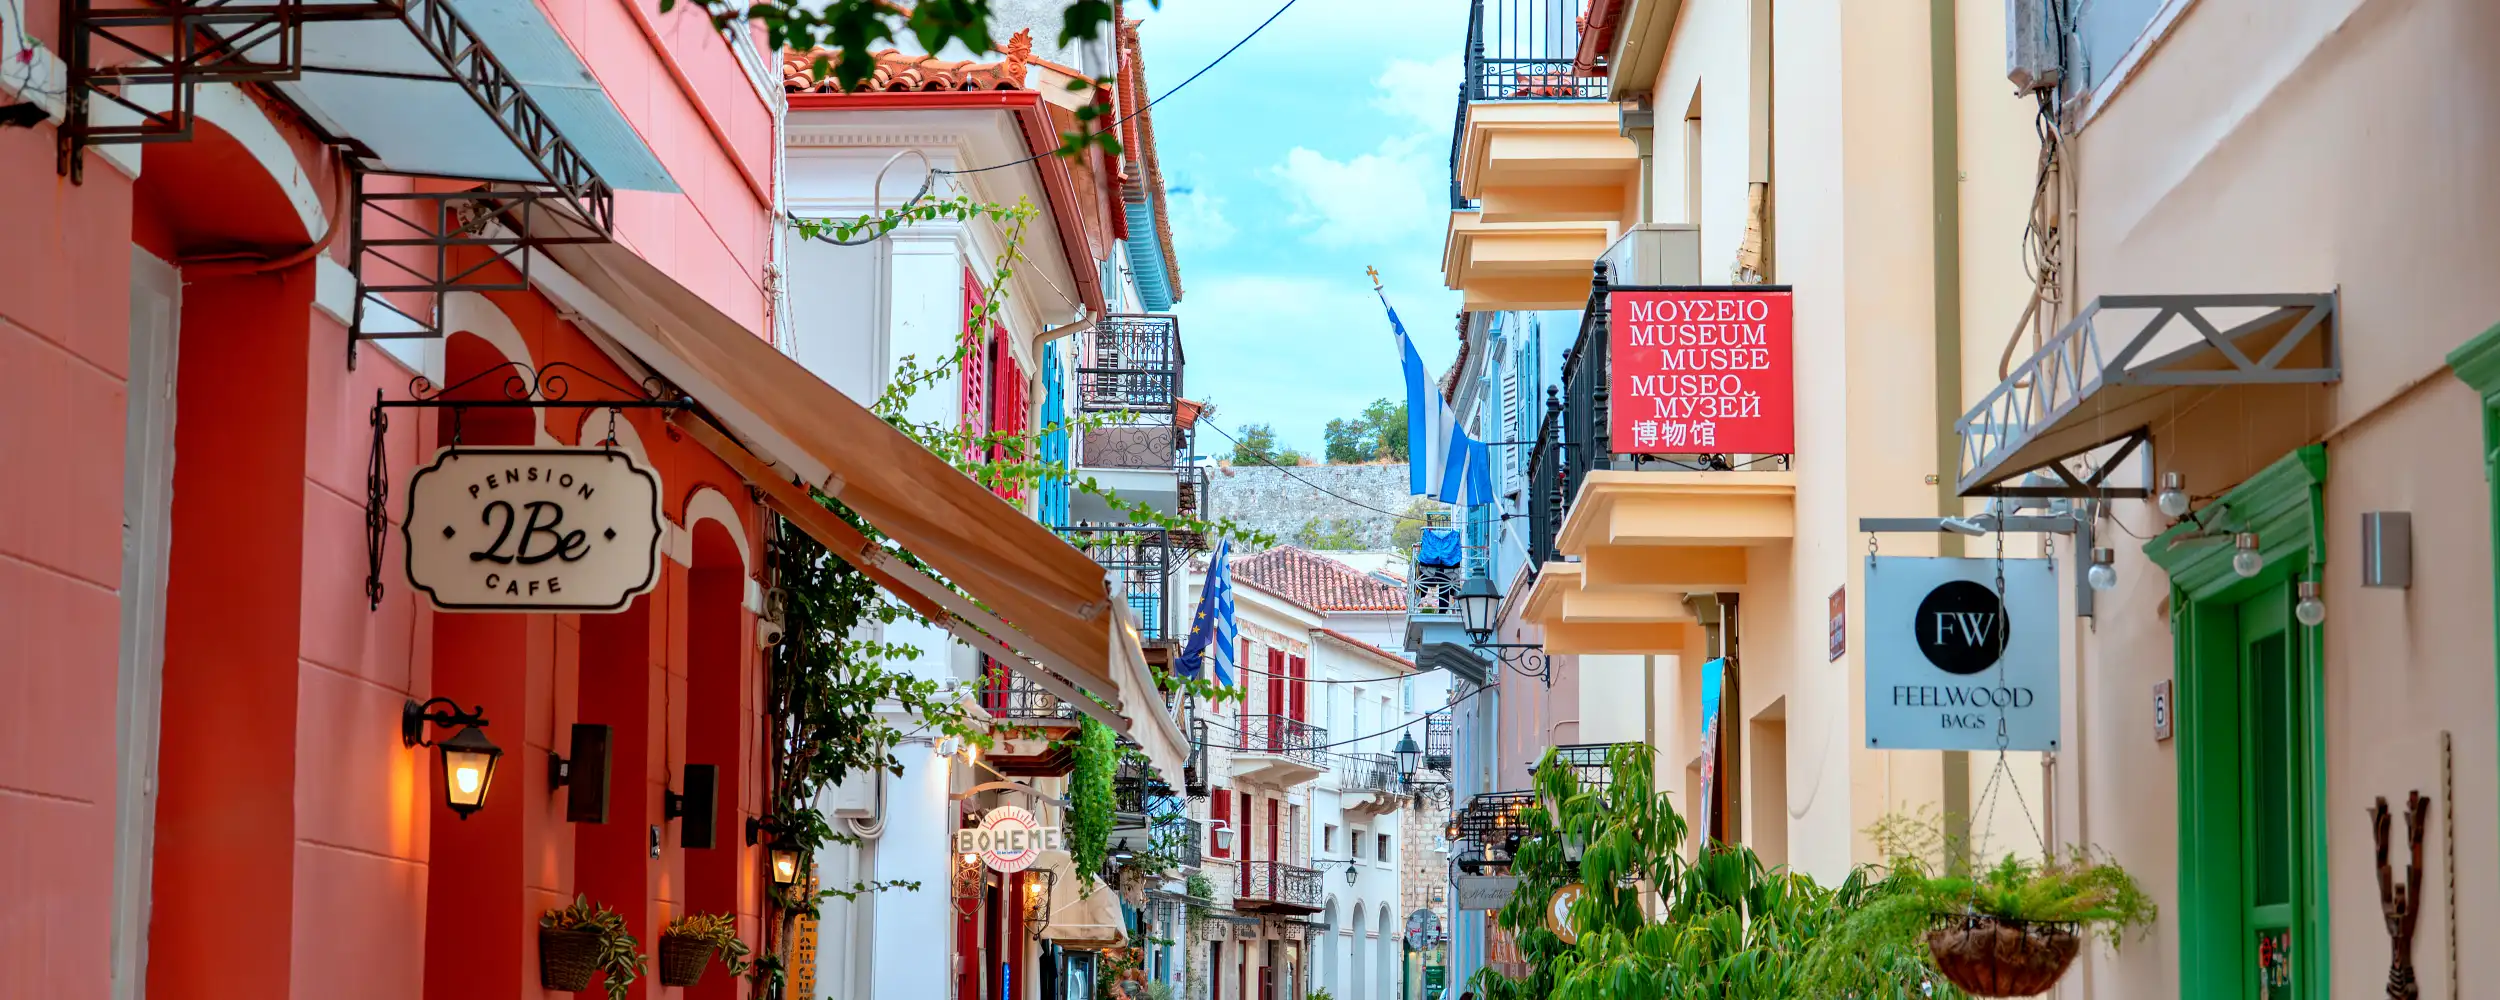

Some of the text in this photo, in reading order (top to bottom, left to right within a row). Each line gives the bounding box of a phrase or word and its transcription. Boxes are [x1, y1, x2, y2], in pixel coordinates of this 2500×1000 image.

[1629, 299, 1769, 322] ΜΟΥΣΕΙΟ
[1629, 323, 1766, 346] MUSEUM
[1661, 345, 1770, 371] MUSÉE
[1631, 374, 1742, 397] MUSEO
[1653, 390, 1761, 418] МУЗЕЙ
[1632, 419, 1716, 447] 博物馆
[468, 467, 594, 500] PENSION
[469, 500, 591, 565] 2Be
[485, 573, 562, 597] CAFE
[1932, 611, 1996, 648] FW
[1892, 685, 2034, 708] FEELWOOD
[1941, 713, 1986, 729] BAGS
[2155, 695, 2165, 725] 6
[960, 829, 1058, 852] BOHEME
